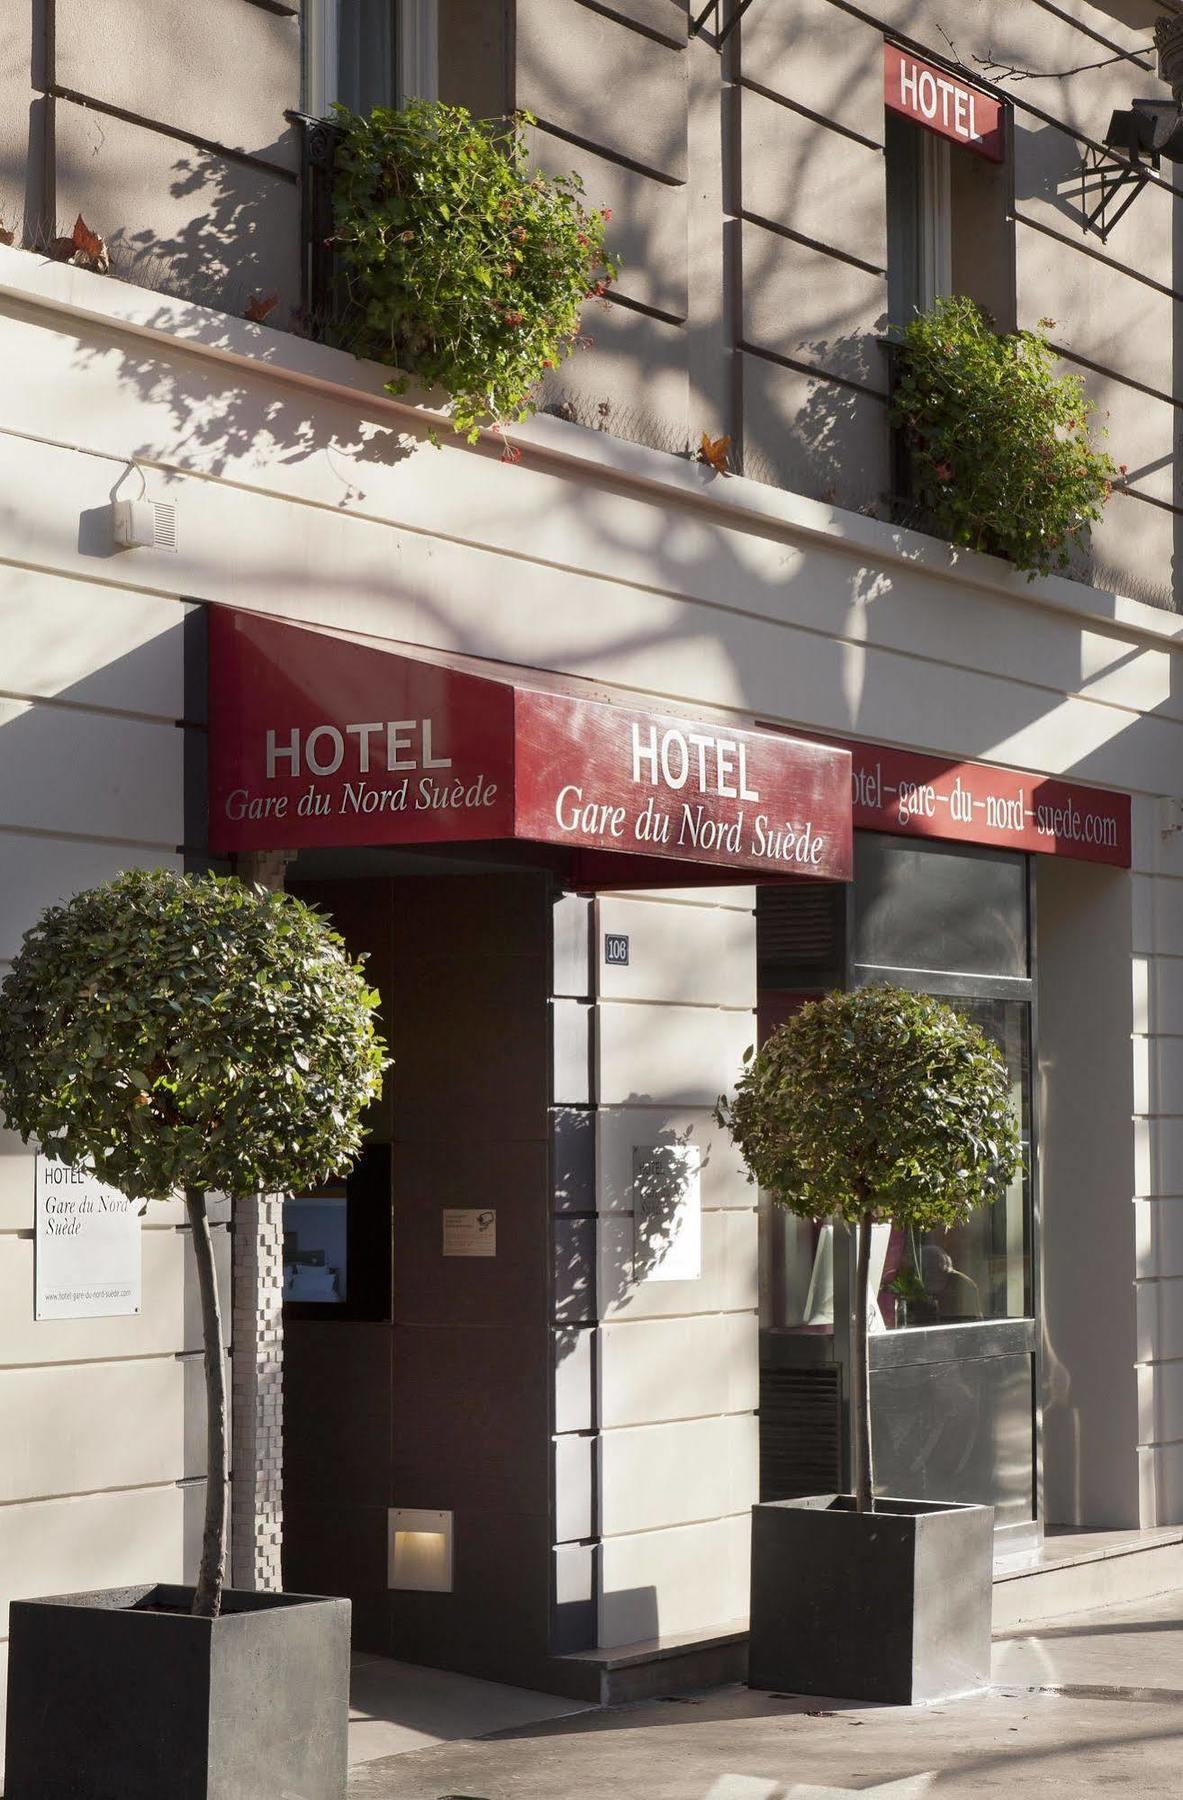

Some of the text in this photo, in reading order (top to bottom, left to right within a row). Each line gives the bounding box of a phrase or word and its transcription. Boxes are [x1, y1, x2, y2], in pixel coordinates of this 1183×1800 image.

[900, 58, 982, 143] HOTEL
[266, 719, 452, 778] HOTEL
[632, 722, 759, 802] HOTEL
[225, 774, 498, 821] Gare du Nord Suède
[555, 785, 823, 864] Gare du Nord Suède
[45, 1167, 85, 1184] HOTEL
[45, 1195, 76, 1214] Gare
[78, 1194, 94, 1213] du
[46, 1217, 82, 1236] Suède
